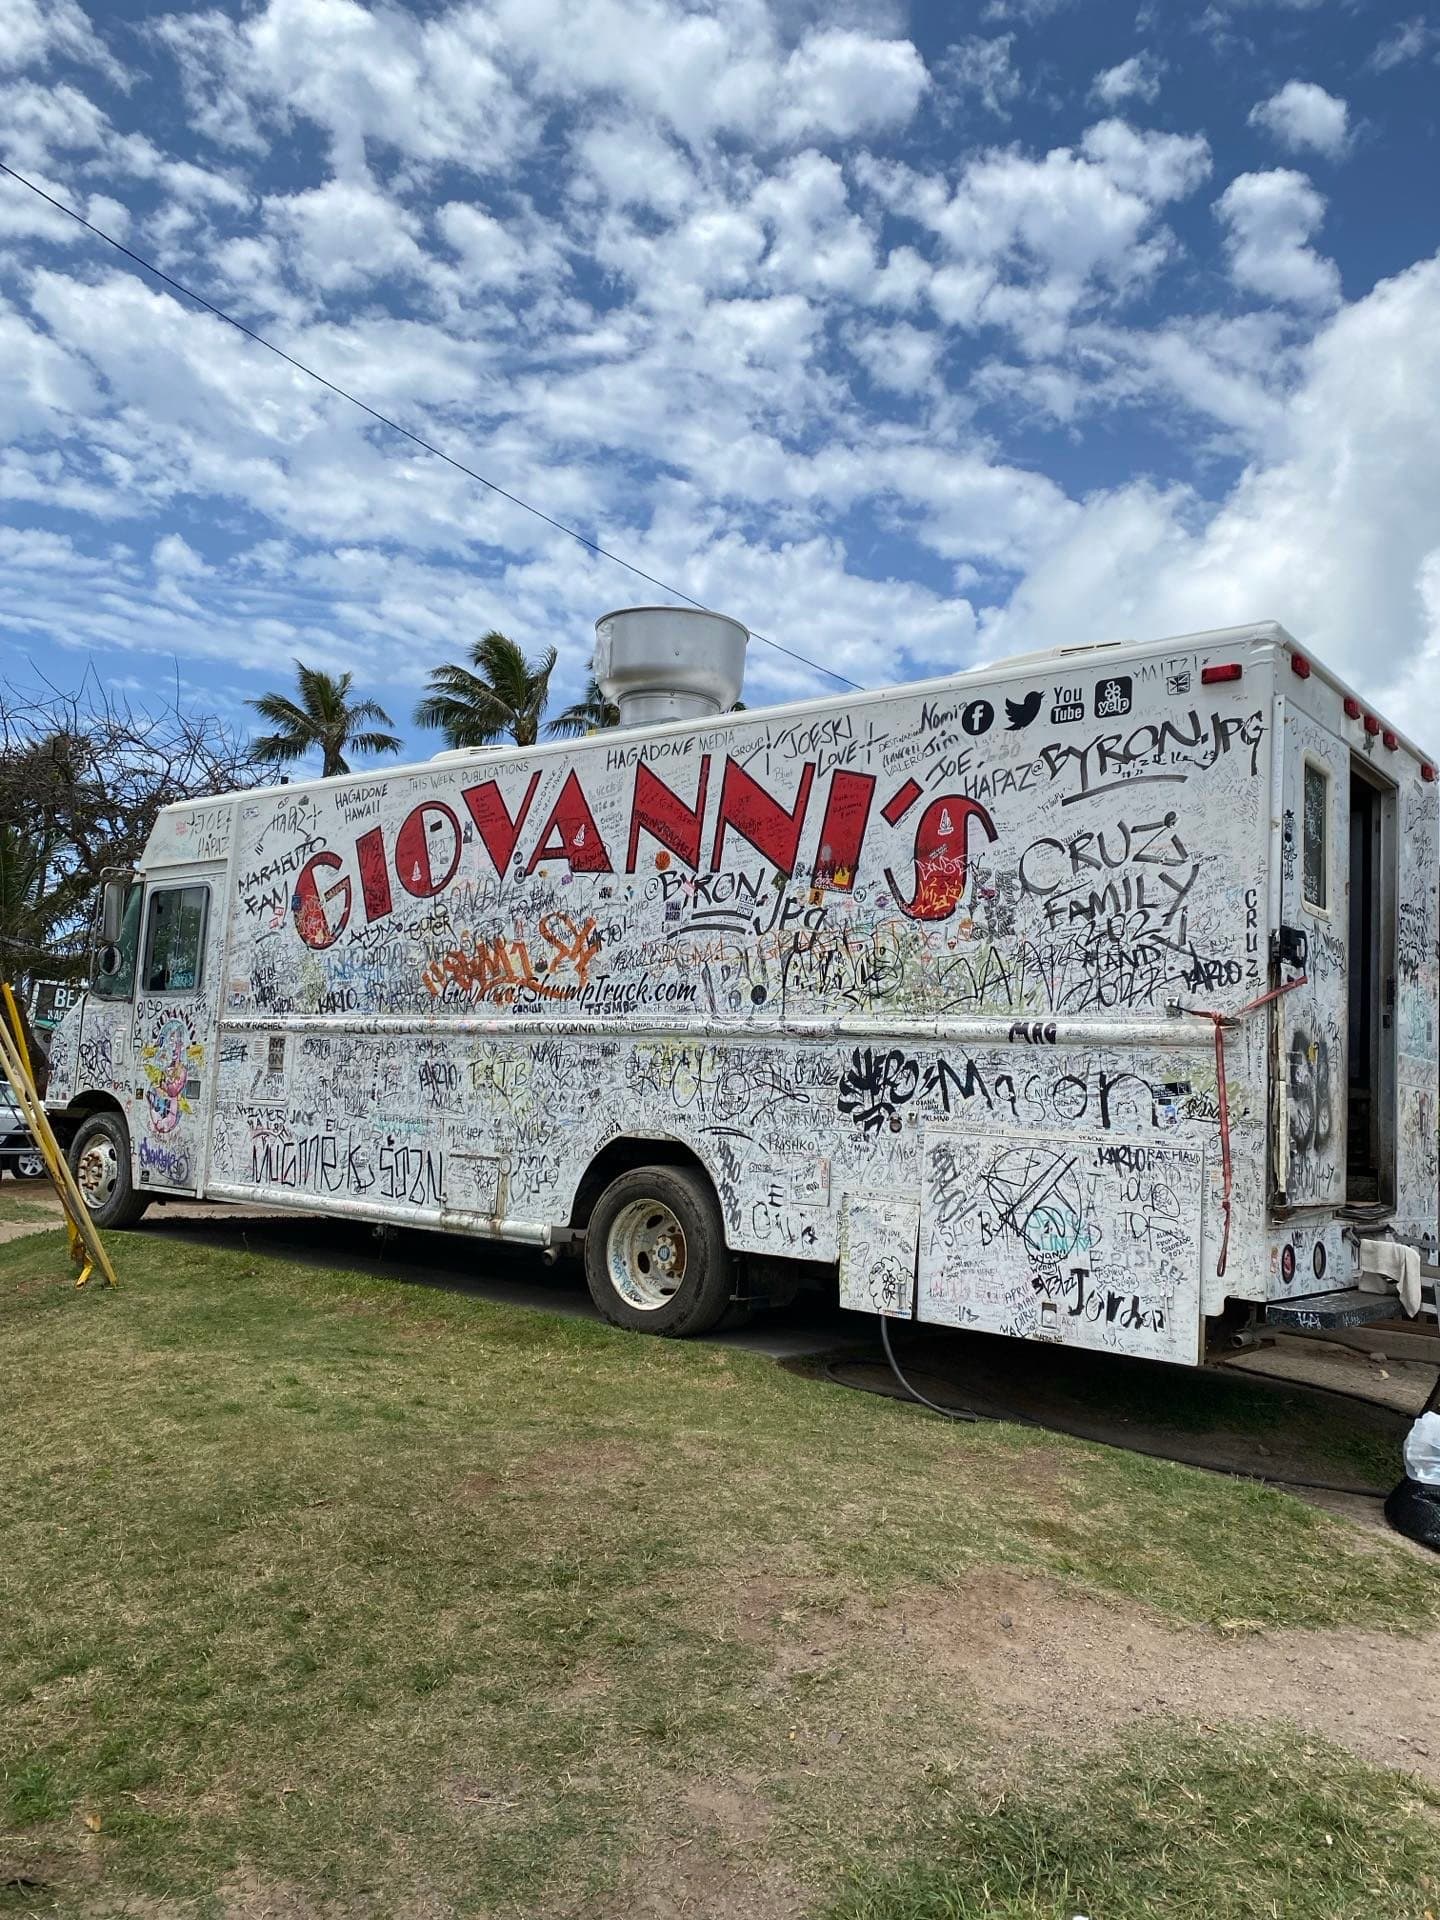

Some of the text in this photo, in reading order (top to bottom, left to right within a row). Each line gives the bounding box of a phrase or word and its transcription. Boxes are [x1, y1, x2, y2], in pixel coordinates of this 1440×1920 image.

[1053, 686, 1083, 703] You
[1053, 705, 1083, 723] Tube
[1098, 698, 1130, 716] yelp
[606, 737, 697, 772] HAGADONE
[430, 771, 455, 789] WEEK
[461, 761, 529, 785] PUBLICATIONS
[335, 785, 389, 811] HAGADONE
[344, 801, 381, 825] HAWAII
